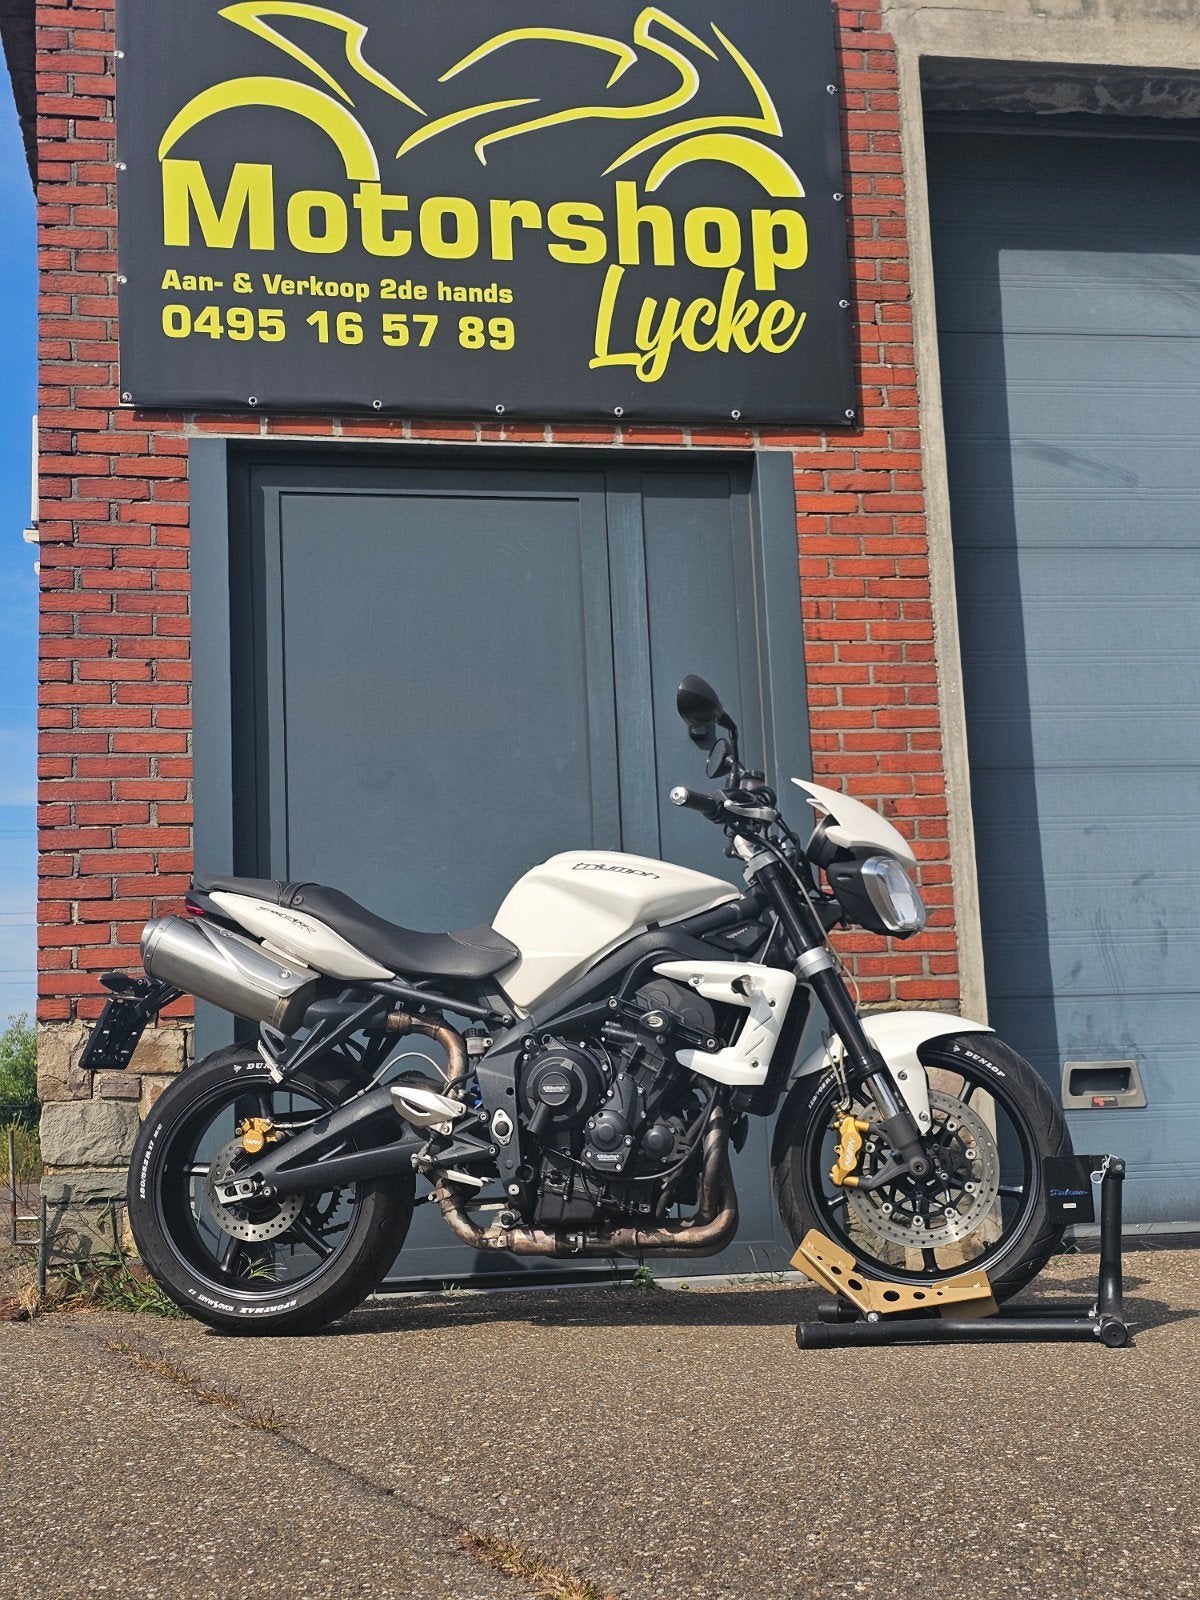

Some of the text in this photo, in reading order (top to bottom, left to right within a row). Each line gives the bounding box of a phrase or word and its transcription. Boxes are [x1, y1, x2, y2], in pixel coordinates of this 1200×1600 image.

[161, 158, 809, 291] Motorshop
[161, 269, 514, 305] Aan- & Verkoop 2de hands
[162, 304, 516, 351] 0495 16 57 89
[588, 263, 807, 383] Lycke
[964, 1050, 1006, 1077] DUNLOP
[239, 1299, 298, 1314] SPORTMAX
